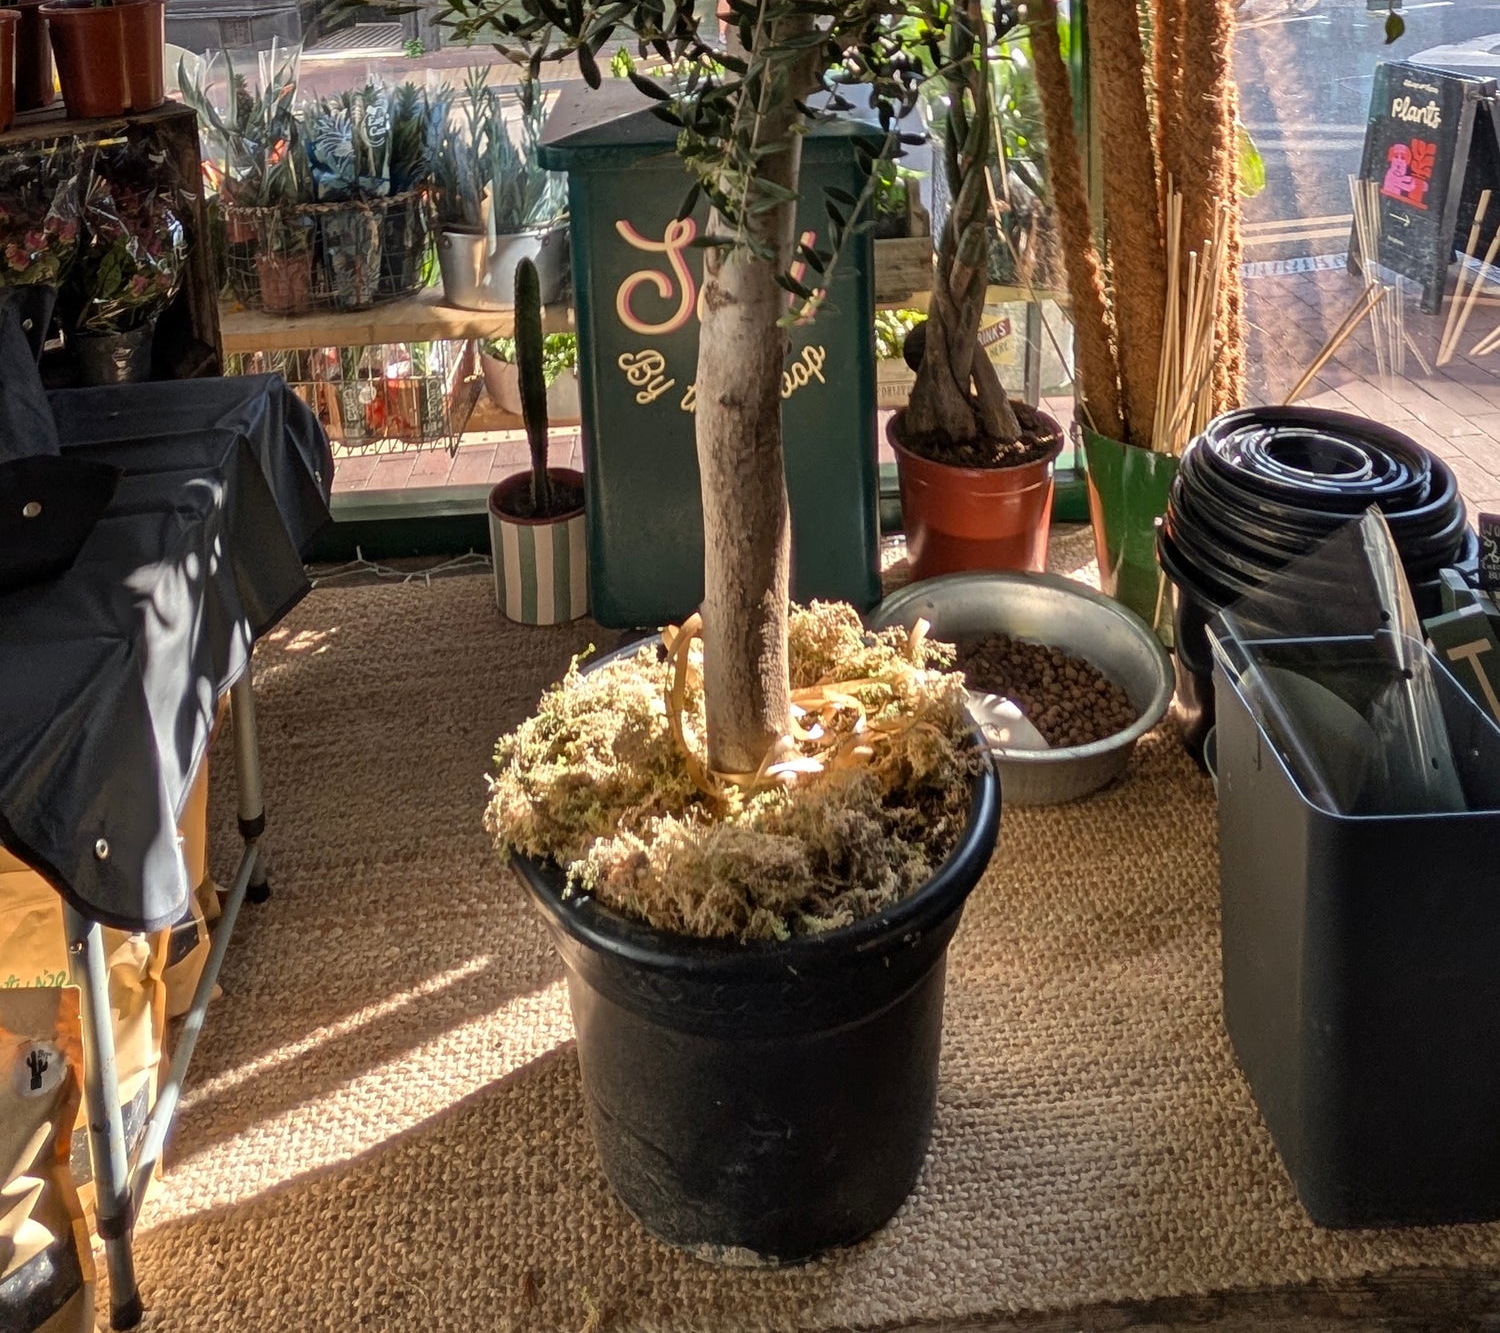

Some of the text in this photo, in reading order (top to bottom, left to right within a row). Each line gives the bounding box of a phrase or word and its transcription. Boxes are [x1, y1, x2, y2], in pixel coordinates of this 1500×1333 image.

[1391, 95, 1442, 129] Plants
[977, 321, 1008, 347] RINKS
[618, 349, 675, 405] By
[781, 345, 826, 399] oop
